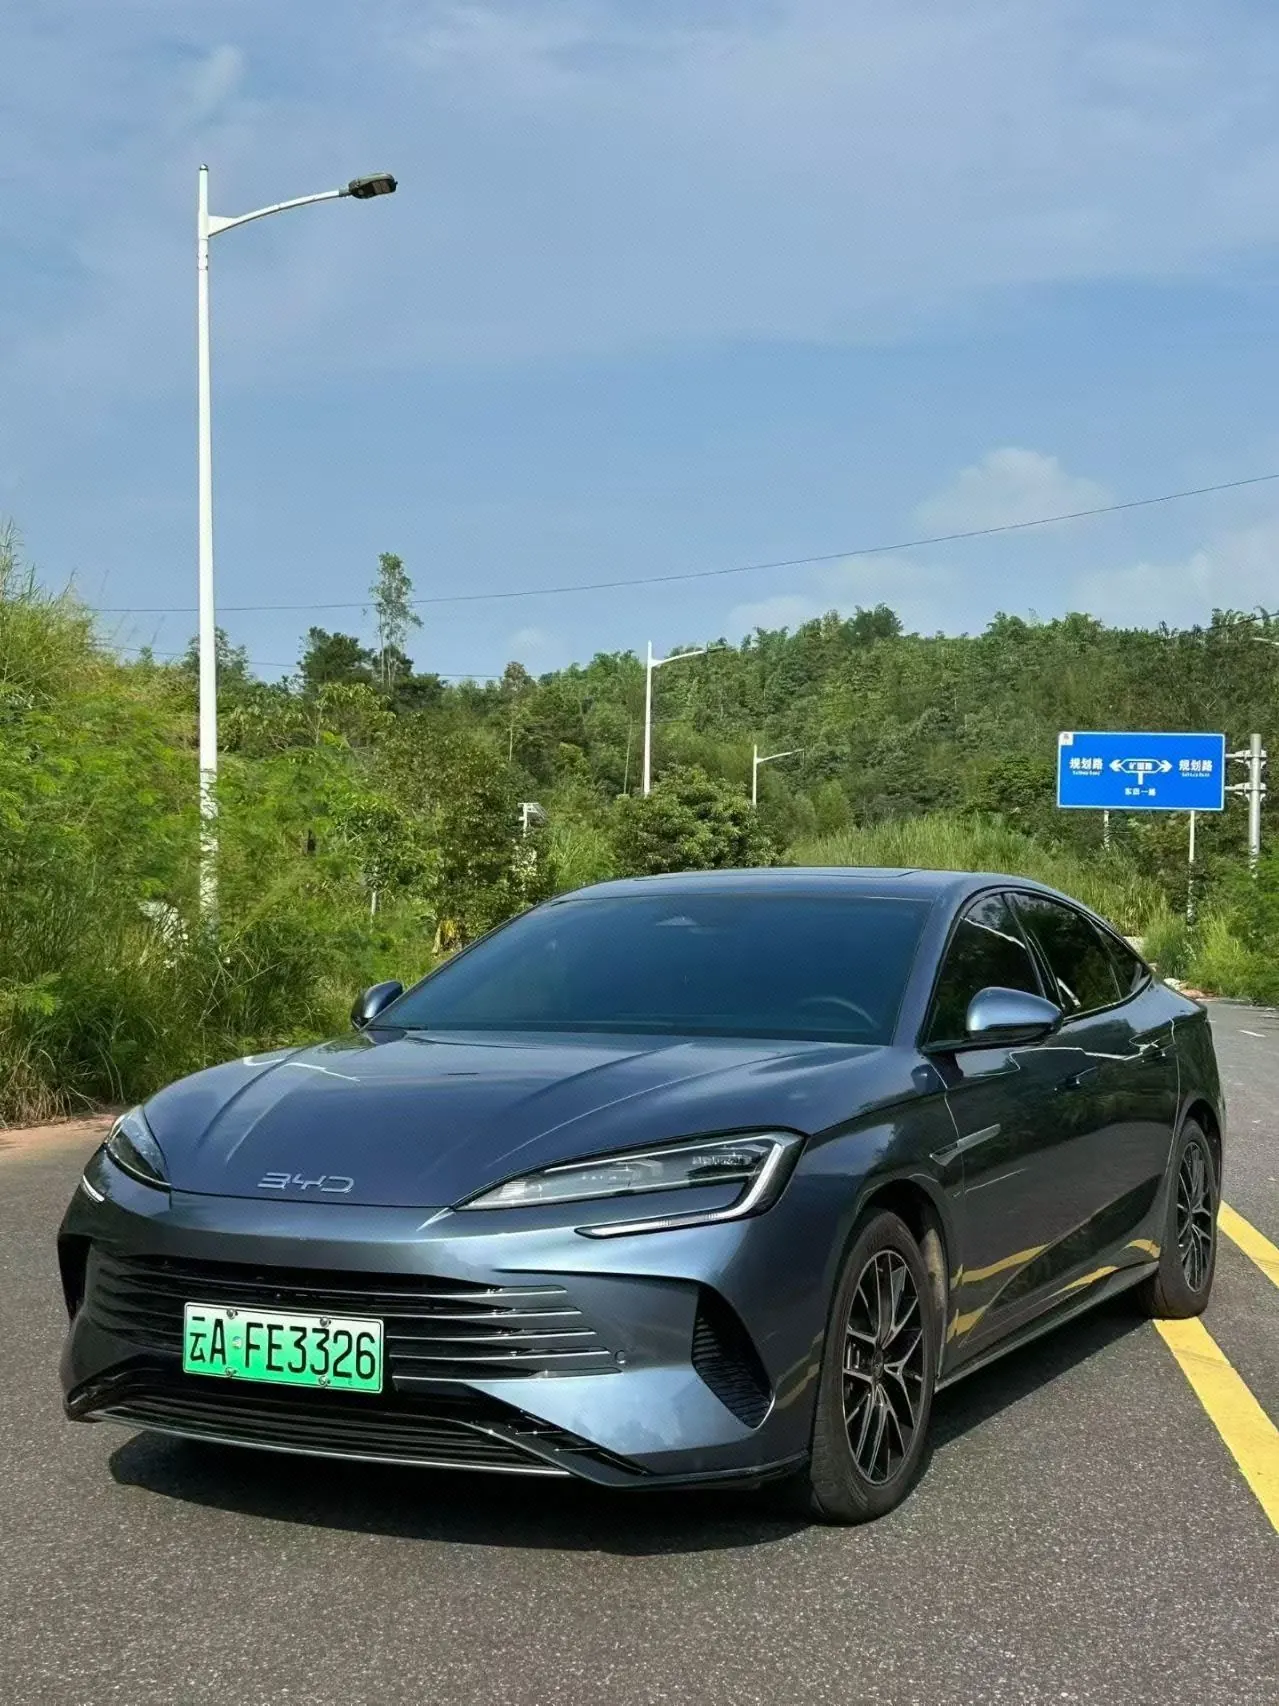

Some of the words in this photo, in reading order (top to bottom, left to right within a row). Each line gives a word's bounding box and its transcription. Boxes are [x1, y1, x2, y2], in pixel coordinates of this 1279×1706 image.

[1069, 757, 1103, 770] 规划路
[1179, 759, 1213, 771] 规划路
[257, 1171, 354, 1194] BYD
